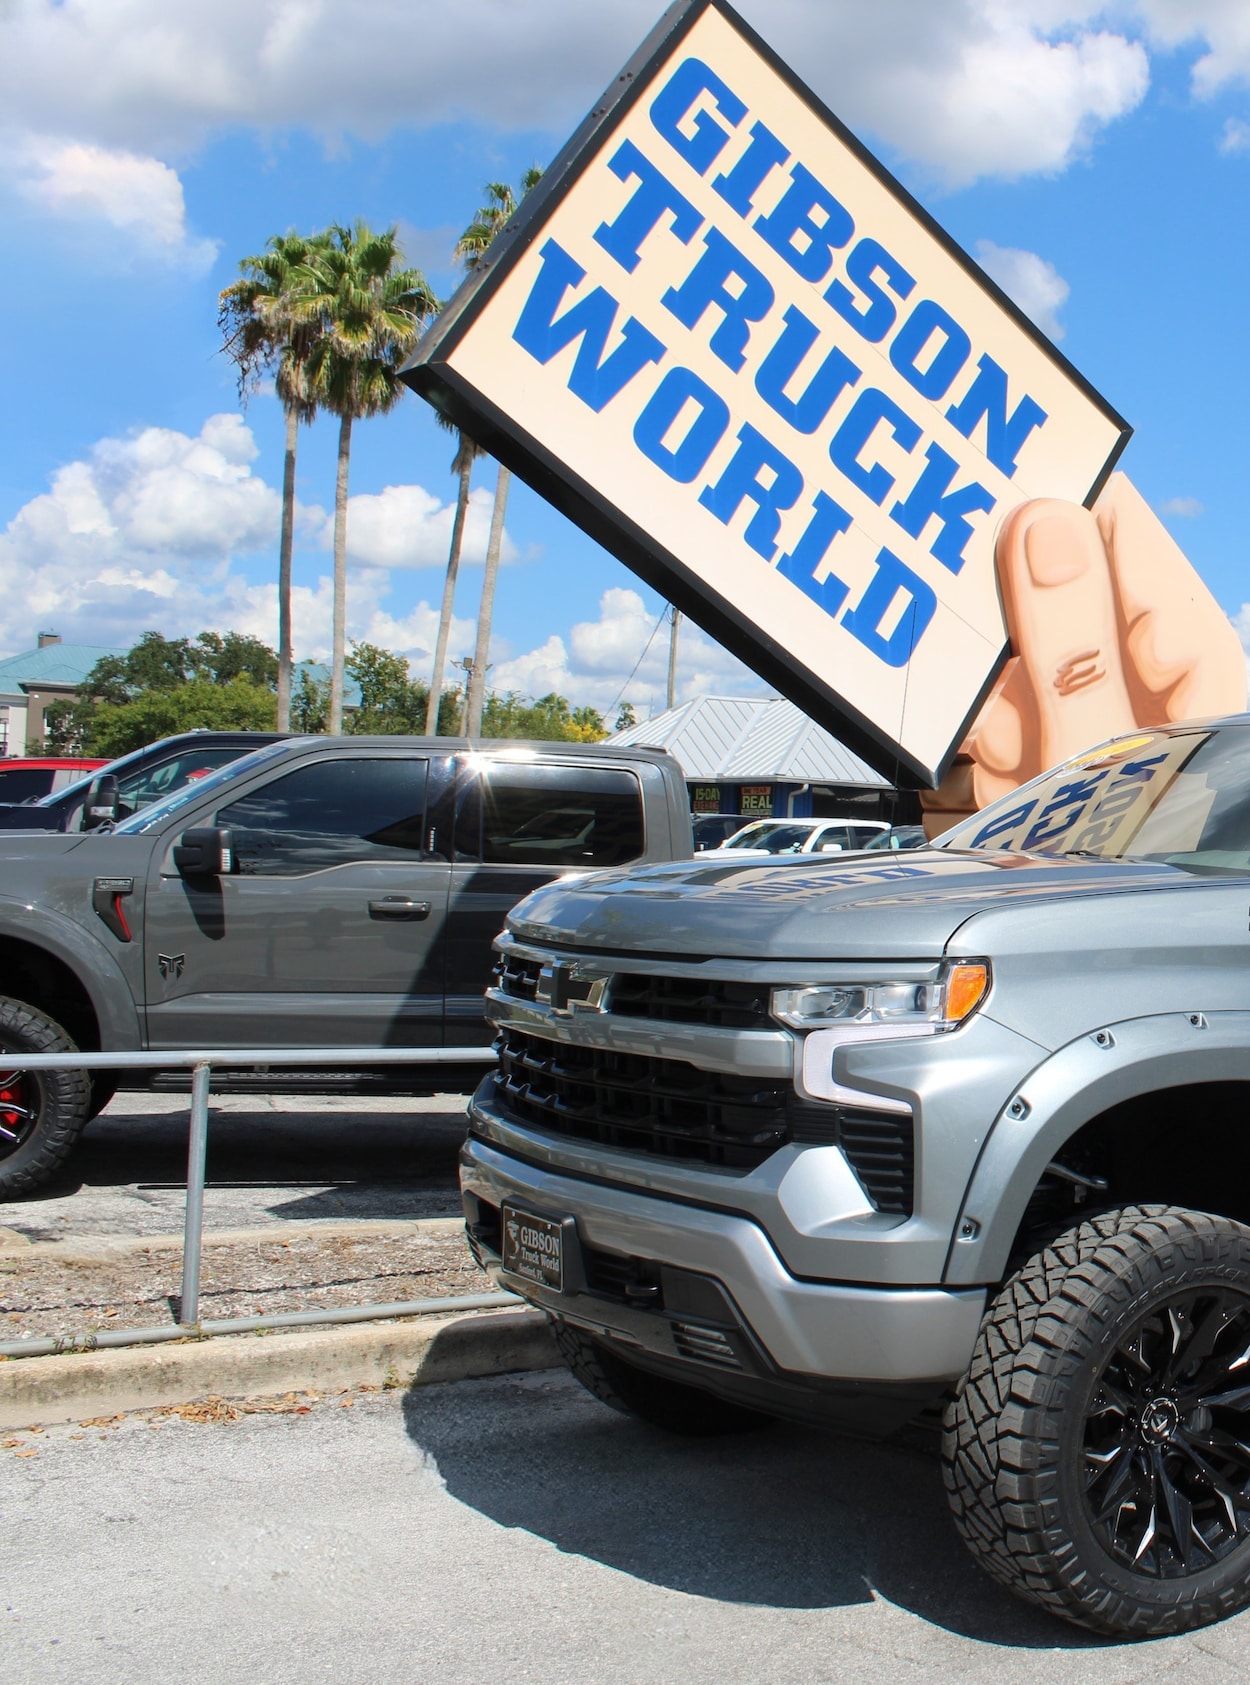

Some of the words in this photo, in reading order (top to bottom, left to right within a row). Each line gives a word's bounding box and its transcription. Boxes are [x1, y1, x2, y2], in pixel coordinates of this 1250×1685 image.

[592, 138, 997, 577] TRUCK
[650, 57, 1048, 480] GIBSON
[511, 237, 938, 669] WORLD
[742, 795, 773, 809] REAL
[521, 1226, 559, 1257] GIBSON
[521, 1247, 539, 1265] Truck
[540, 1253, 560, 1271] World
